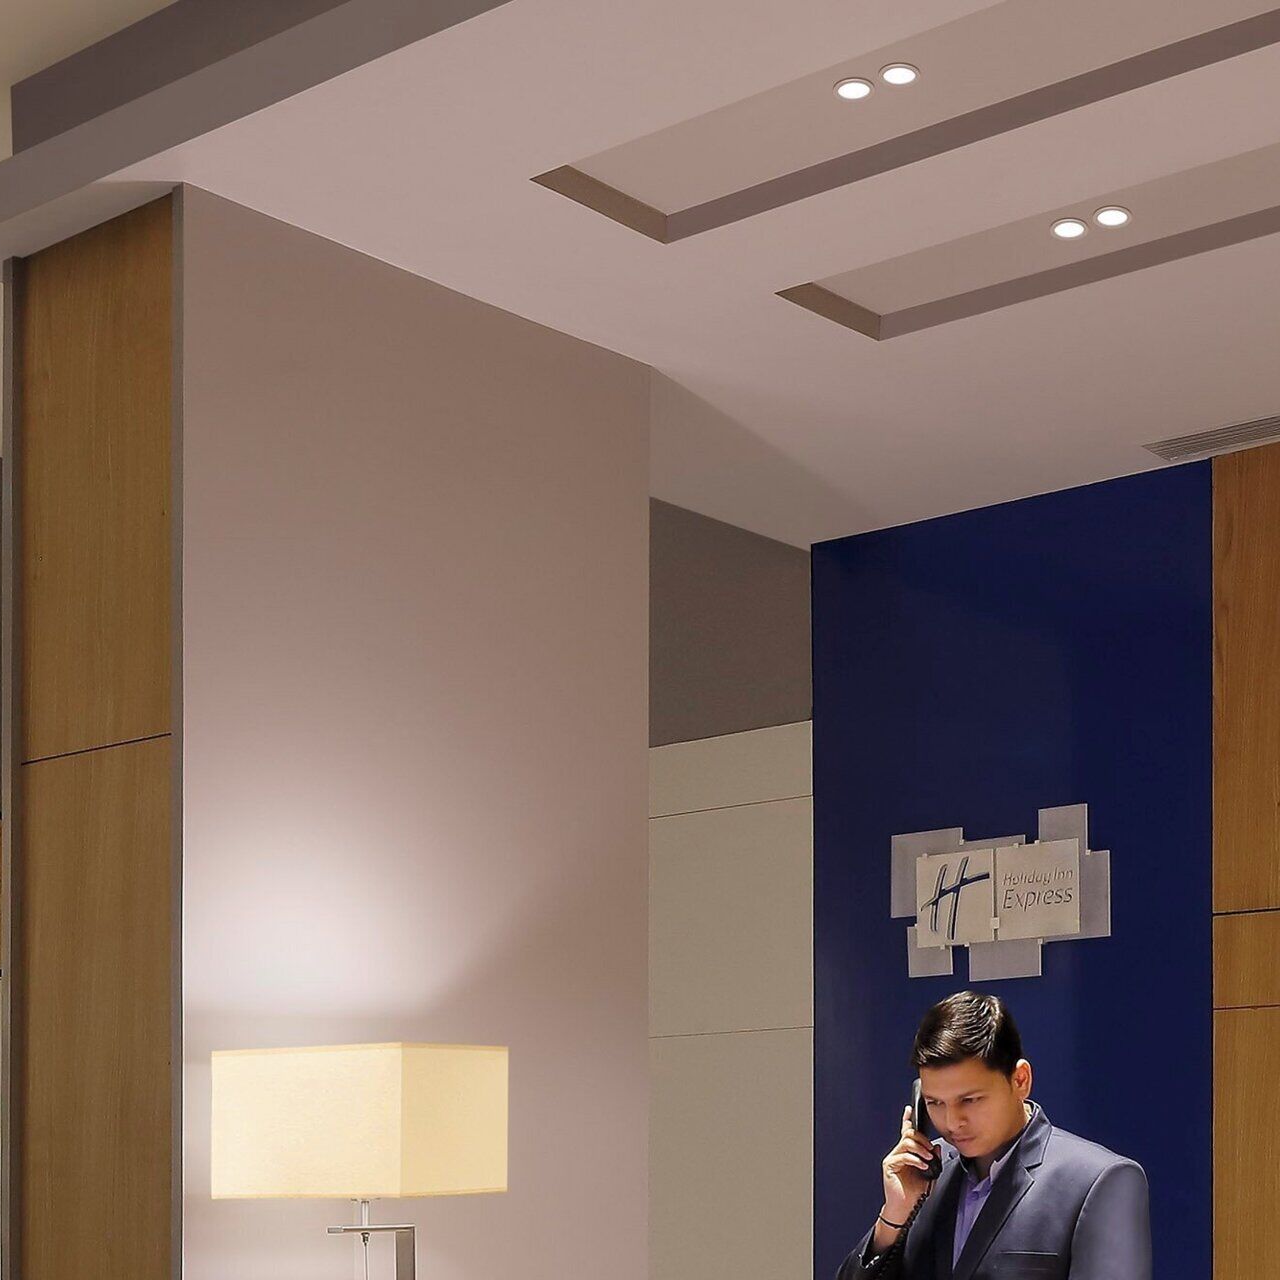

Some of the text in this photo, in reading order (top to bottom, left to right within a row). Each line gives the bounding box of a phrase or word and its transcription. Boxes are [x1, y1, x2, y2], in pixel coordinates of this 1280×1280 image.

[1003, 866, 1073, 886] Holiday Inn
[1003, 887, 1073, 912] Express
